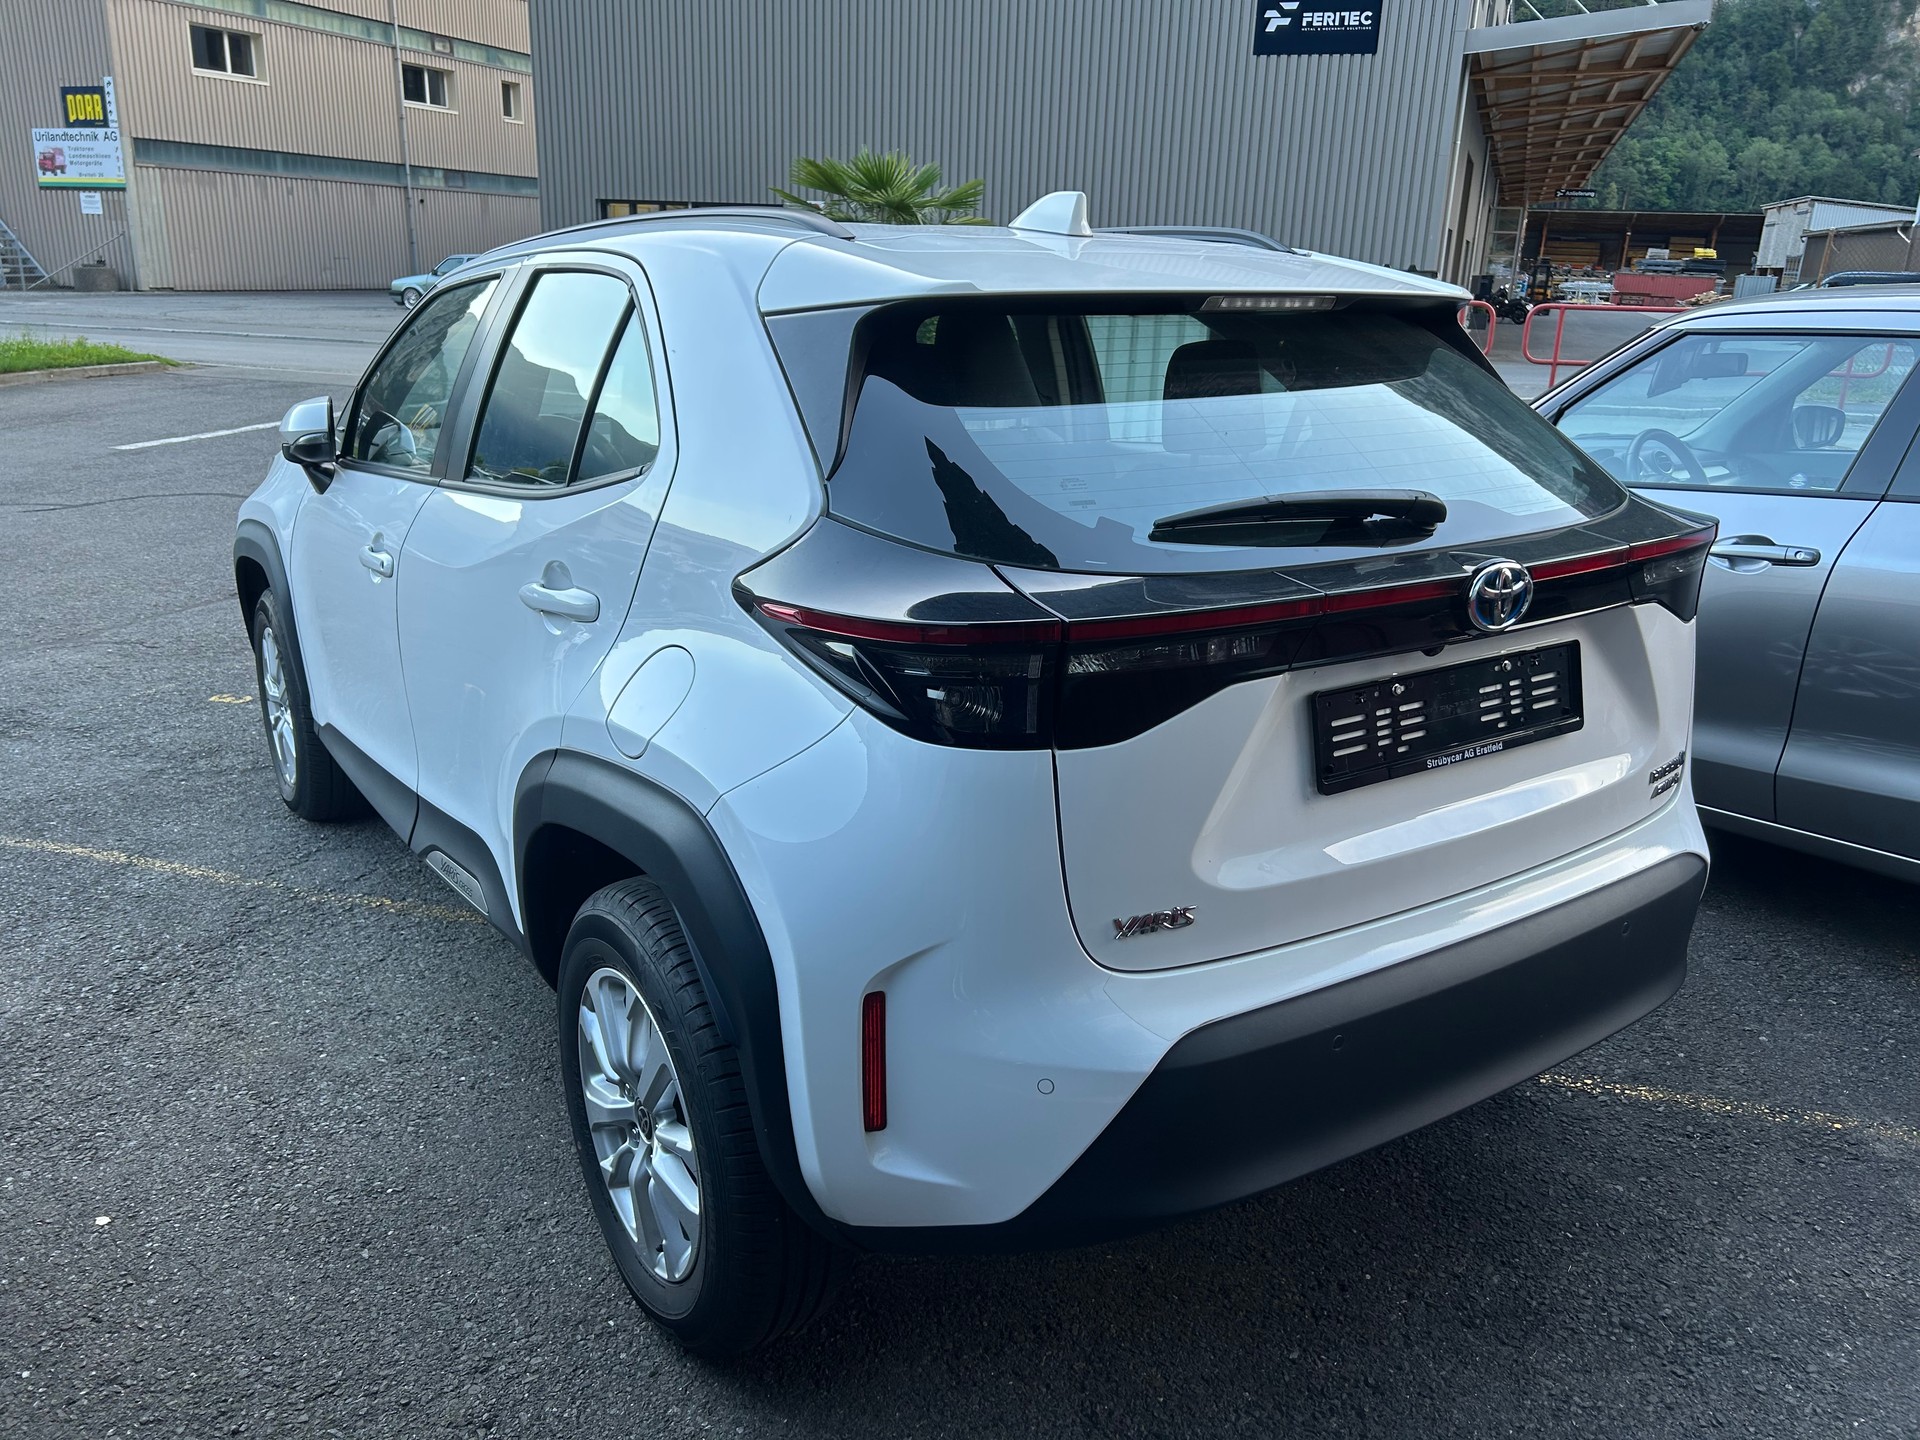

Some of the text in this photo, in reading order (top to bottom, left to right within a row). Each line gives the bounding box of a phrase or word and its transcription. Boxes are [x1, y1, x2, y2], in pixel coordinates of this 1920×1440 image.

[1302, 11, 1373, 27] FERITEC
[66, 94, 103, 123] PORR
[34, 131, 118, 142] Urilandtechnik AG
[1427, 741, 1503, 768] Strübycar AG Erstfeld
